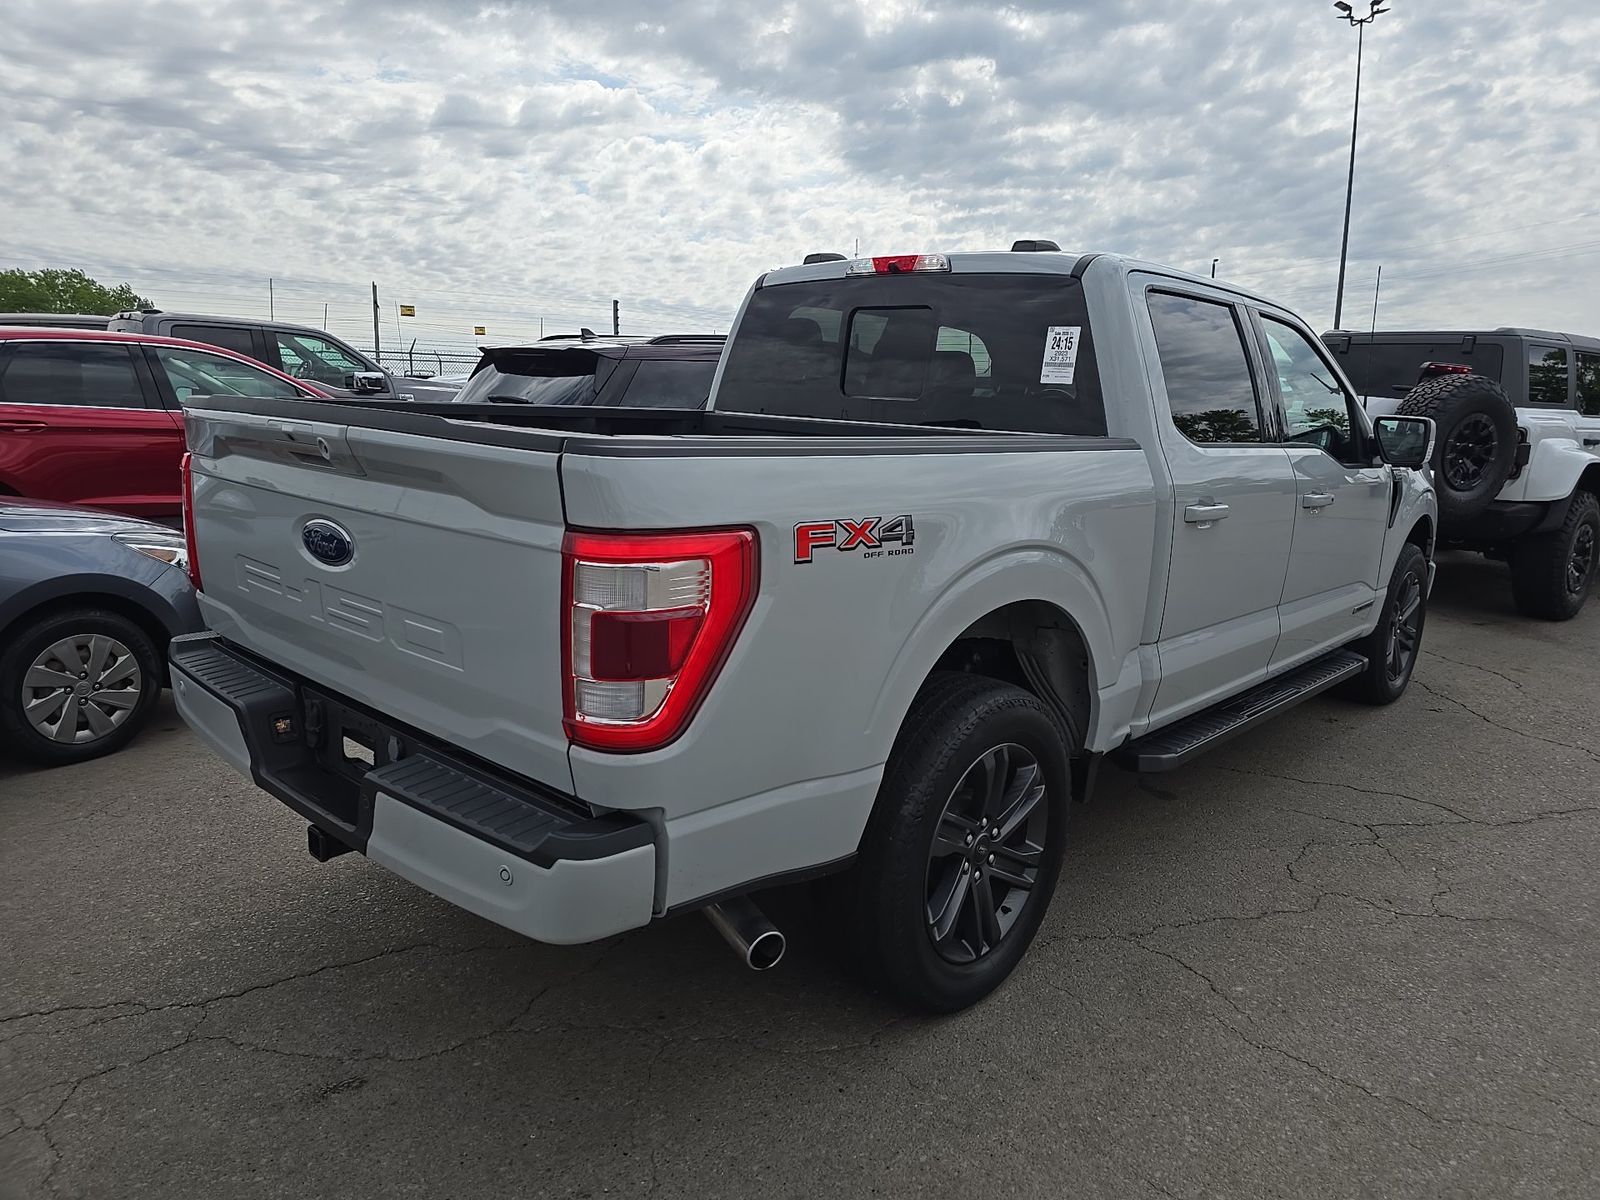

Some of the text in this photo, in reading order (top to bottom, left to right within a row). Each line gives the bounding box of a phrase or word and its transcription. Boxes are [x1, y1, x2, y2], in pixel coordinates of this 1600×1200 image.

[1051, 336, 1074, 350] 24:15
[303, 527, 338, 556] Ford
[793, 514, 915, 565] FX4
[864, 548, 914, 559] OFF ROAD
[234, 553, 464, 672] F-150
